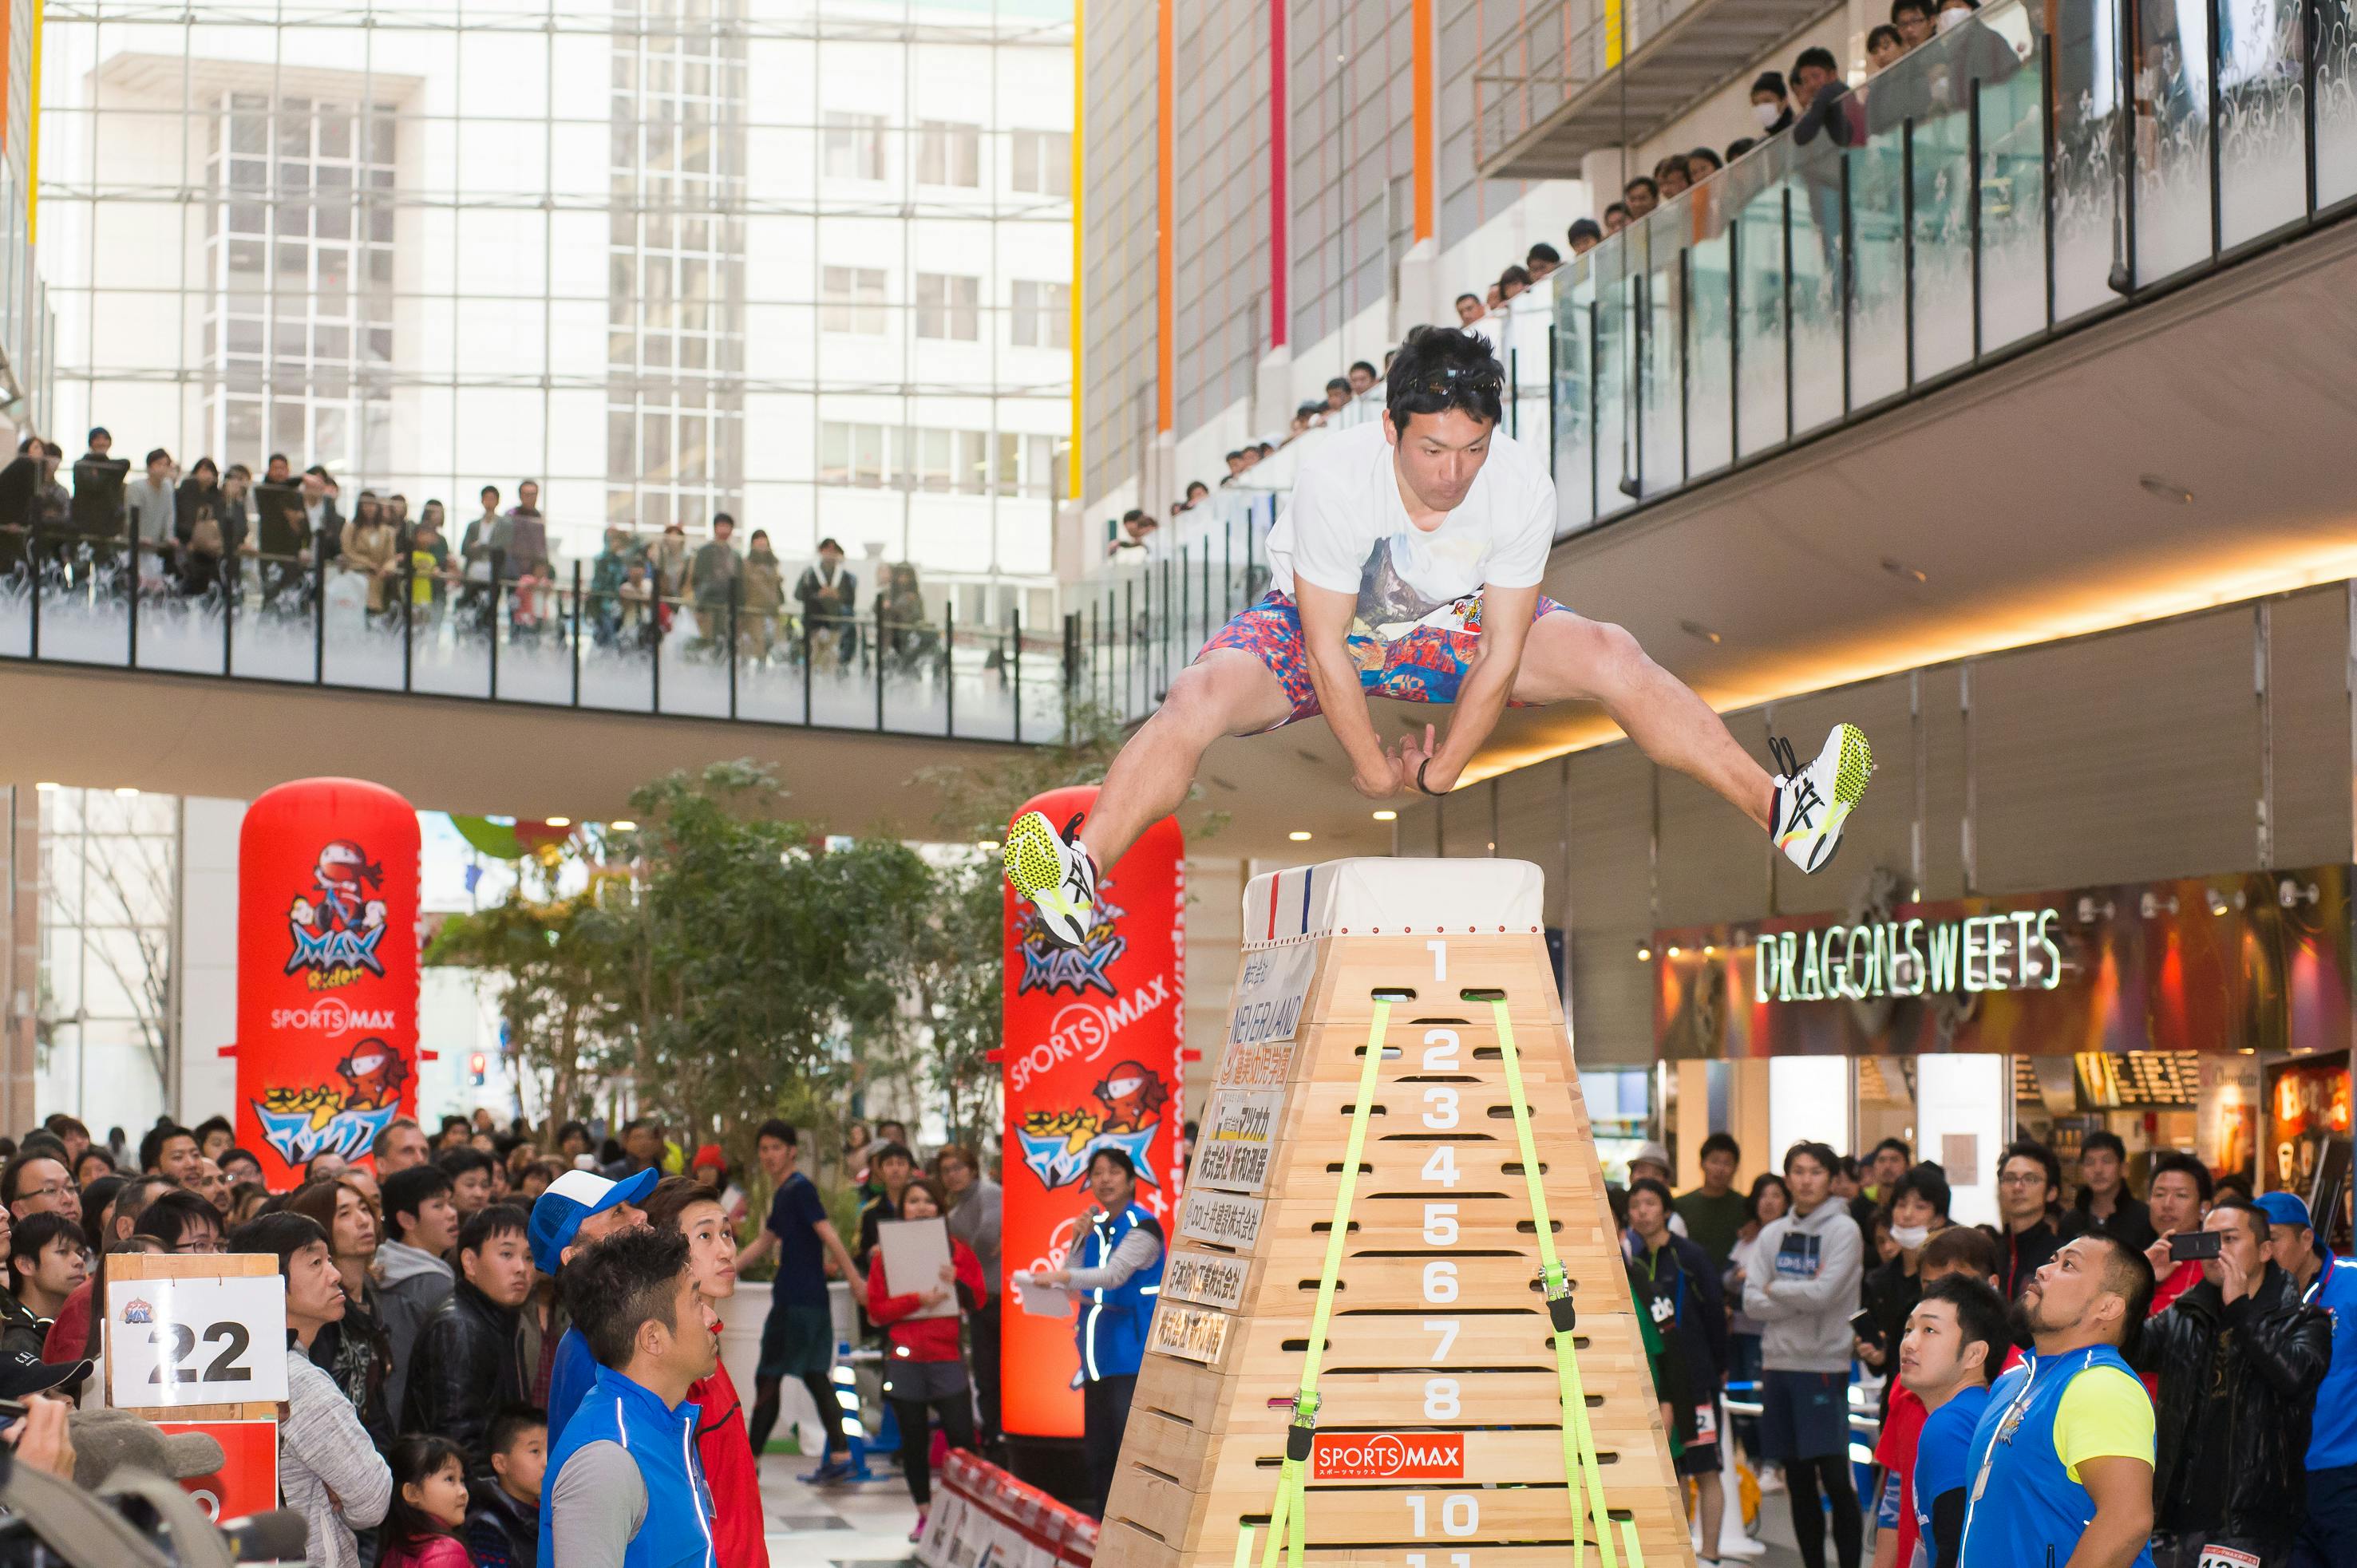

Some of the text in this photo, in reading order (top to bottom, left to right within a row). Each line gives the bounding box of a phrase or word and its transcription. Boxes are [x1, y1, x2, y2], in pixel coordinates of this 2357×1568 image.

[1426, 940, 1446, 981] 1
[271, 1009, 395, 1030] SPORTS MAX
[1011, 974, 1170, 1092] SPORTS MAX
[1422, 1029, 1460, 1071] 2
[1422, 1087, 1460, 1129] 3
[1421, 1146, 1461, 1187] 4
[1422, 1203, 1460, 1246] 5
[1422, 1261, 1459, 1304] 6
[148, 1321, 251, 1384] 22
[1423, 1321, 1460, 1362] 7
[1423, 1378, 1461, 1420] 8
[1319, 1447, 1460, 1467] SPORTS MAX
[1406, 1494, 1479, 1538] 10
